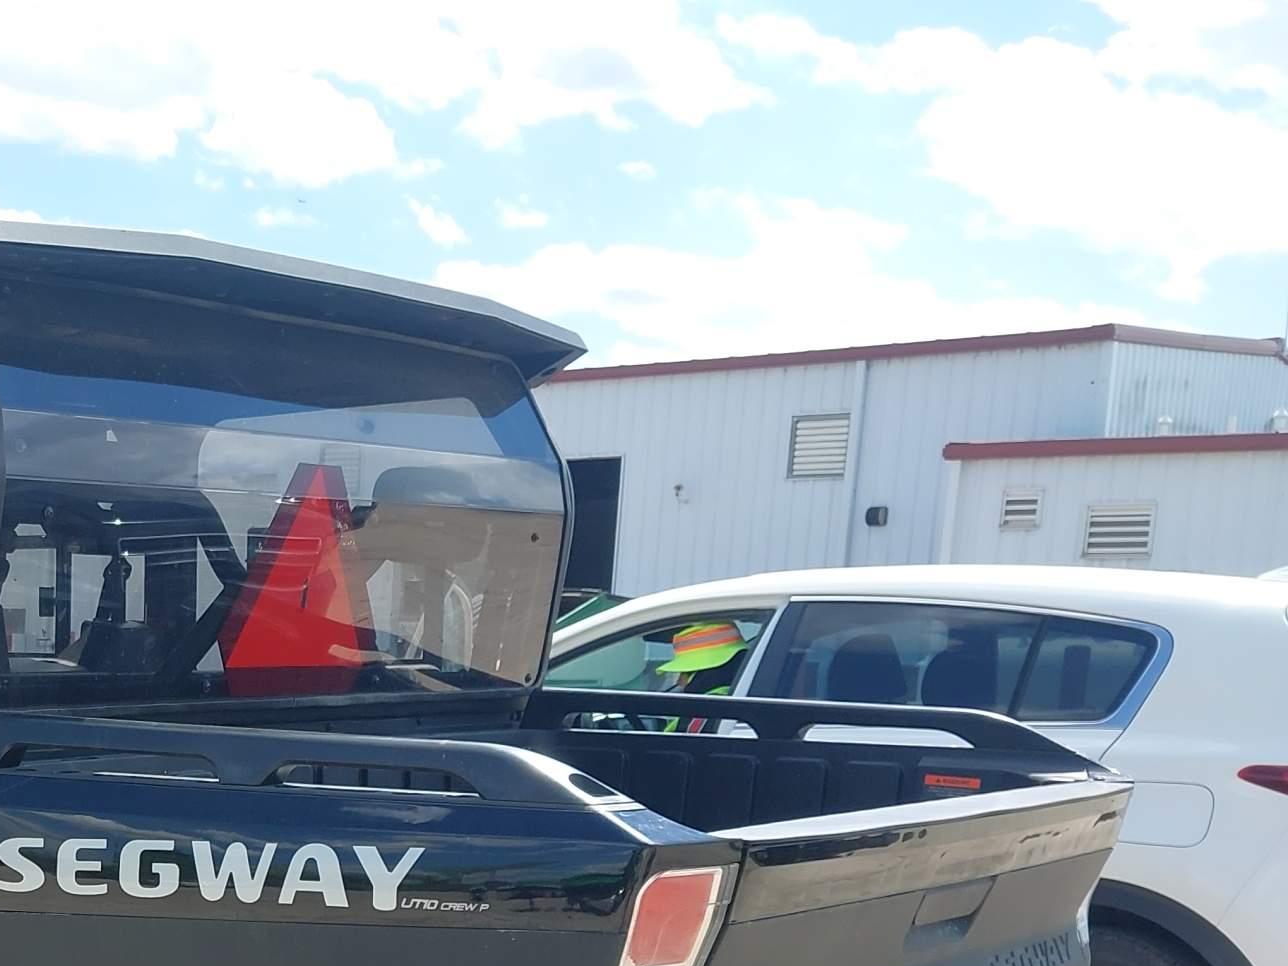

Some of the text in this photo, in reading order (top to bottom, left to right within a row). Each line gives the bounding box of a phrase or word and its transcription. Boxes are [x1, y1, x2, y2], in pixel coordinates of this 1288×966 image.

[400, 897, 490, 912] UT10 CREW P
